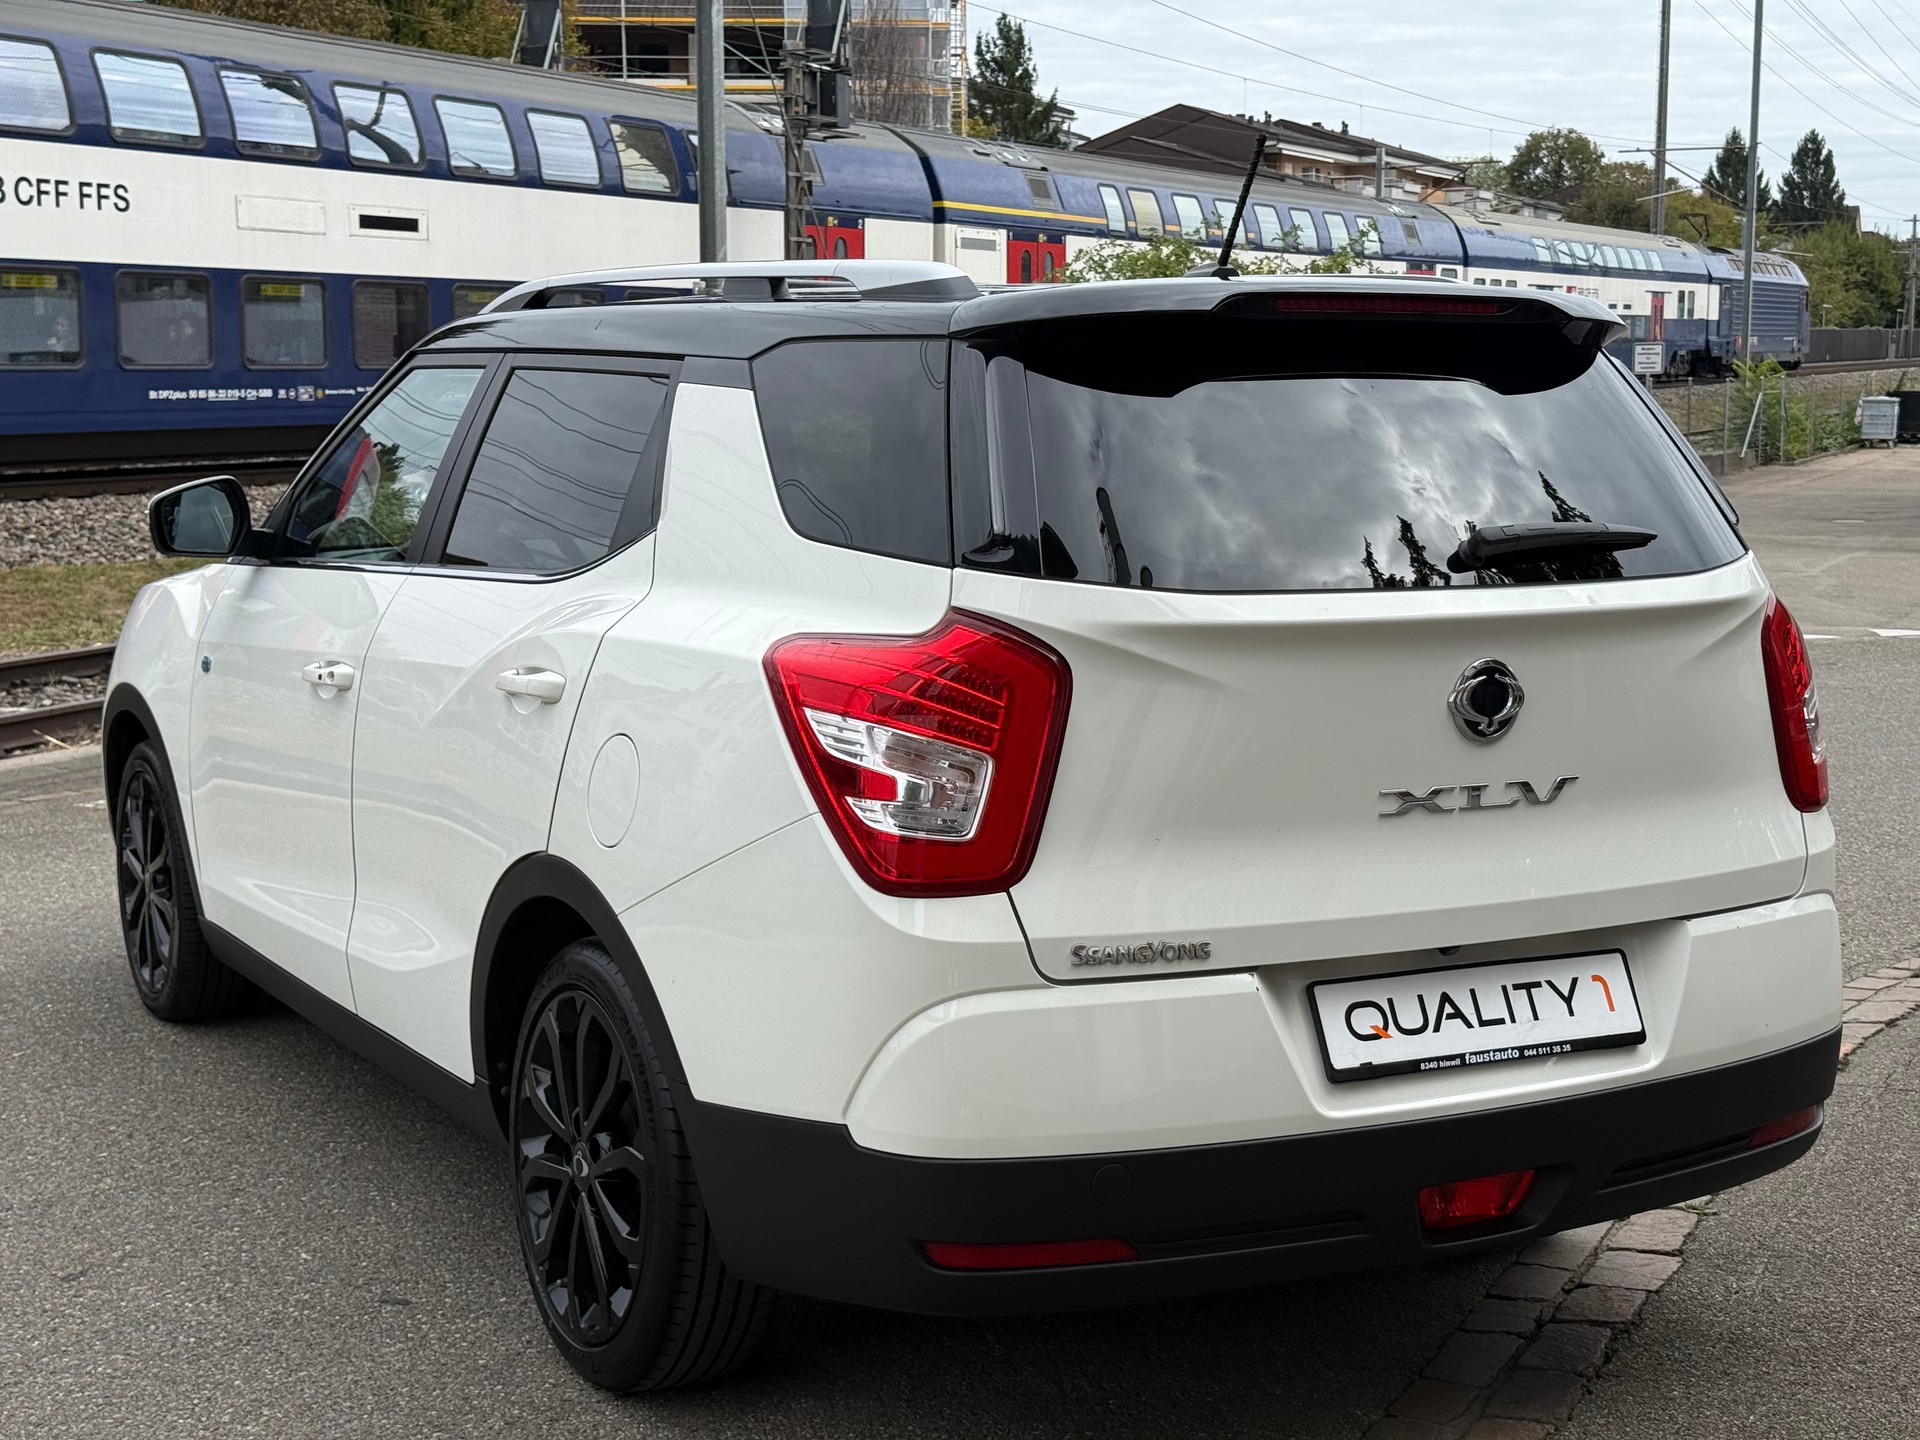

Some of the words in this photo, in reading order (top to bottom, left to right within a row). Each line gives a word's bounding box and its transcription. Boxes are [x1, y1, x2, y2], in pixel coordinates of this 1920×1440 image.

[14, 176, 69, 208] CFF
[78, 181, 131, 213] FFS
[857, 218, 864, 229] 2
[1378, 775, 1579, 817] XLV
[1344, 976, 1579, 1042] QUALITY
[1590, 974, 1616, 1012] 1
[1420, 1060, 1438, 1070] 8340
[1439, 1058, 1461, 1068] hinwil
[1464, 1048, 1520, 1064] faustauto
[1523, 1048, 1537, 1057] 044
[1538, 1046, 1551, 1055] 511
[1552, 1045, 1561, 1053] 35
[1562, 1043, 1571, 1052] 35
